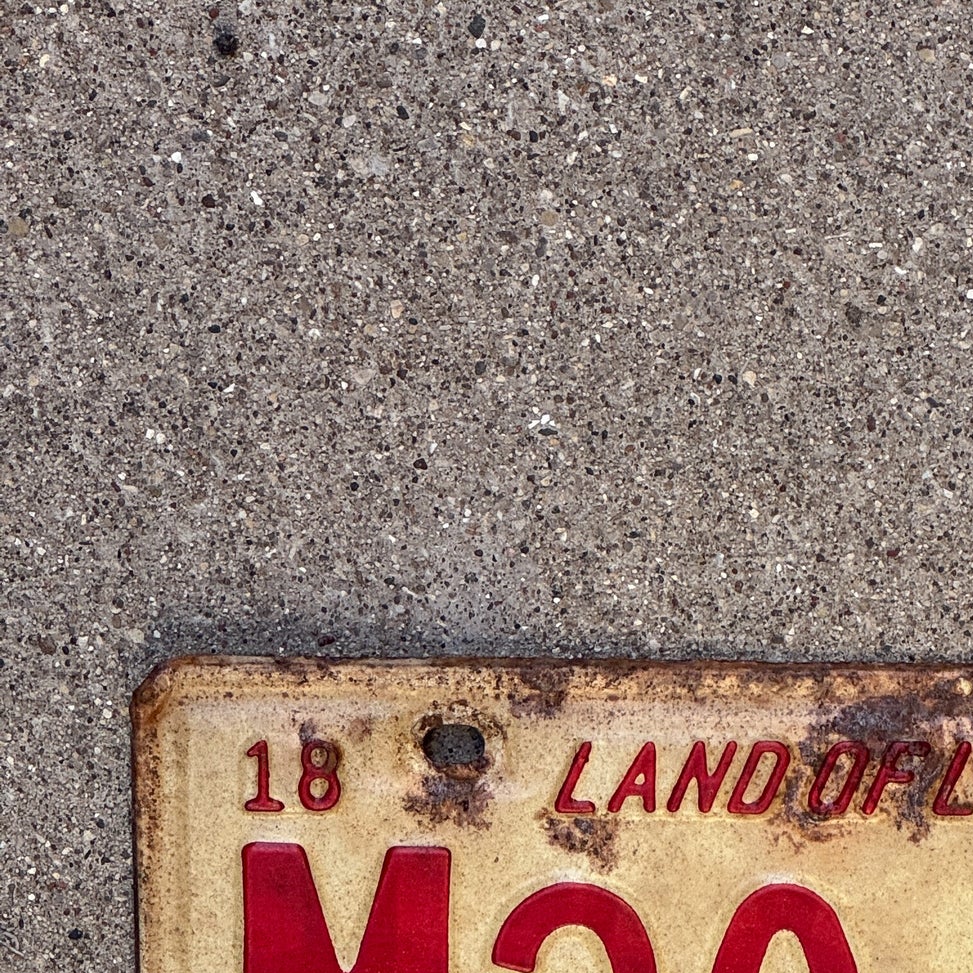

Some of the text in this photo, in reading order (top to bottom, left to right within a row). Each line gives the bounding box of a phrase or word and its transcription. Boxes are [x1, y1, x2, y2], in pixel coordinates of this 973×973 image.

[244, 739, 342, 812] 18
[554, 740, 791, 815] LAND
[807, 740, 932, 816] OF
